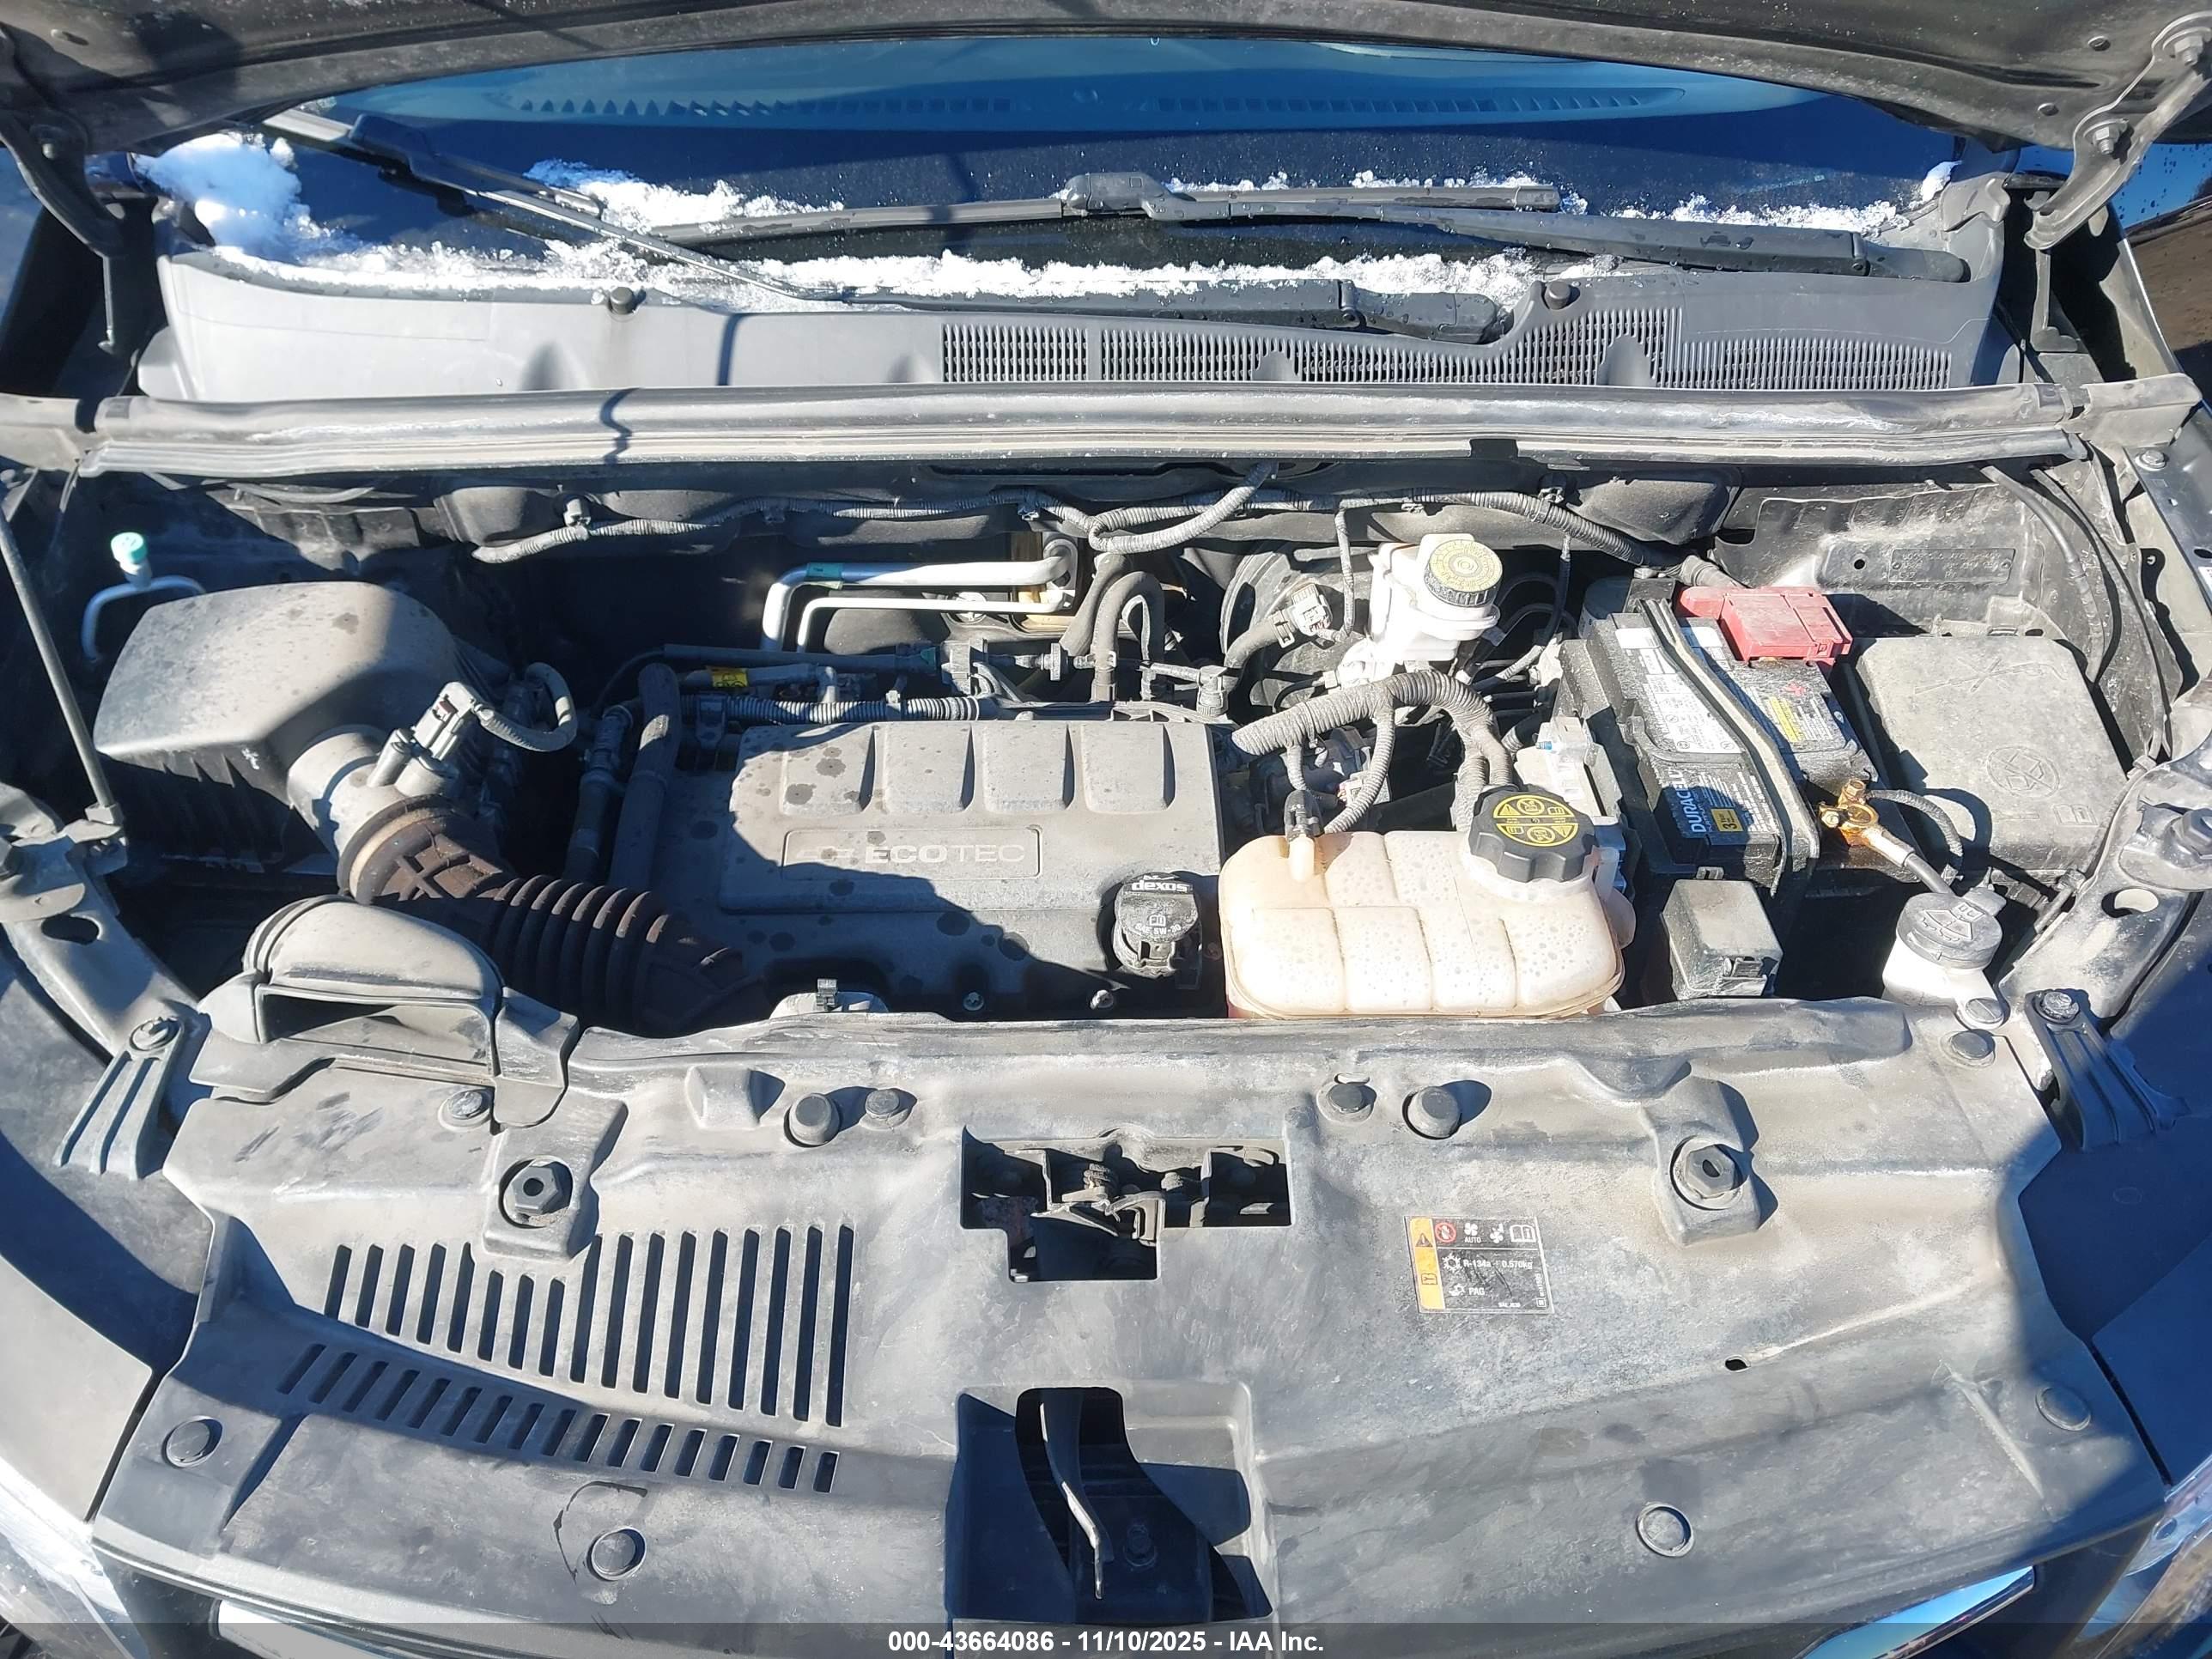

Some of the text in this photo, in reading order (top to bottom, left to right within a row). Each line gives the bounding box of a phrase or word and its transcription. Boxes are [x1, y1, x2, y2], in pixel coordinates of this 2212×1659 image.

[865, 843, 1025, 864] ECOTEC
[1131, 879, 1188, 893] dexos
[1134, 923, 1153, 935] SAE
[1462, 1259, 1492, 1268] R-134a
[1468, 1287, 1486, 1296] PAG
